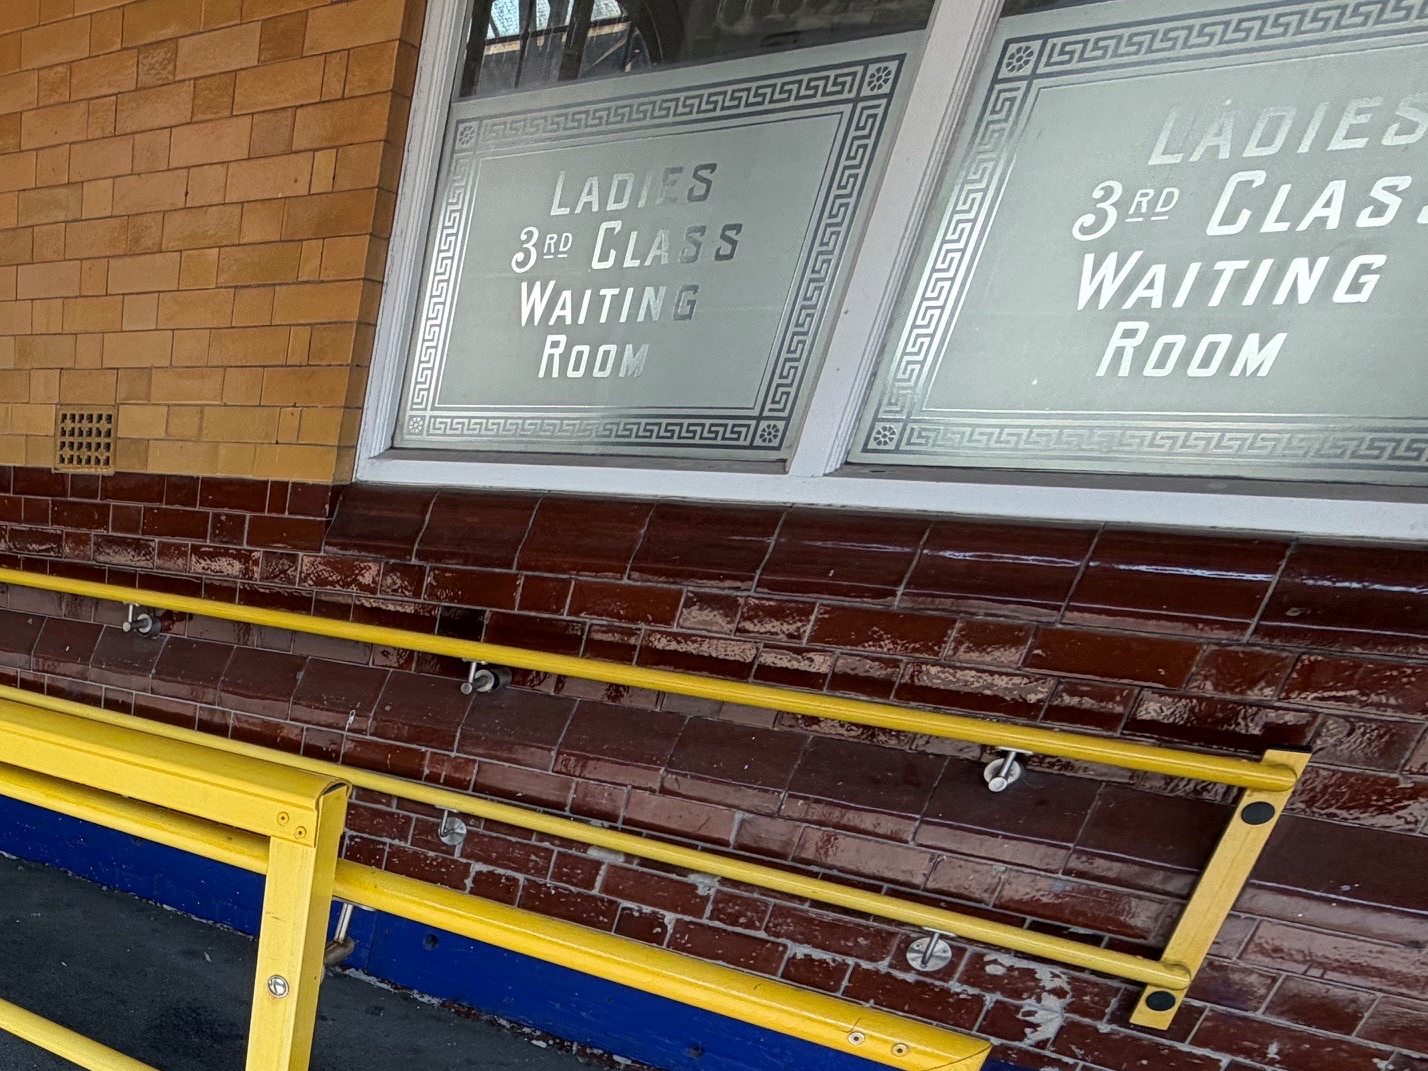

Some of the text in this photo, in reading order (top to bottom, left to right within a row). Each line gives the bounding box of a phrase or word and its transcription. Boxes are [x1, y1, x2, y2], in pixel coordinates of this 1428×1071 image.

[1148, 90, 1428, 167] LADIES
[551, 162, 718, 217] LADIES
[1206, 170, 1428, 236] CLAS
[591, 220, 743, 271] CLASS
[519, 280, 699, 328] WAITING
[1076, 250, 1388, 311] WAITING
[538, 334, 649, 379] ROOM
[1095, 320, 1289, 378] ROOM
